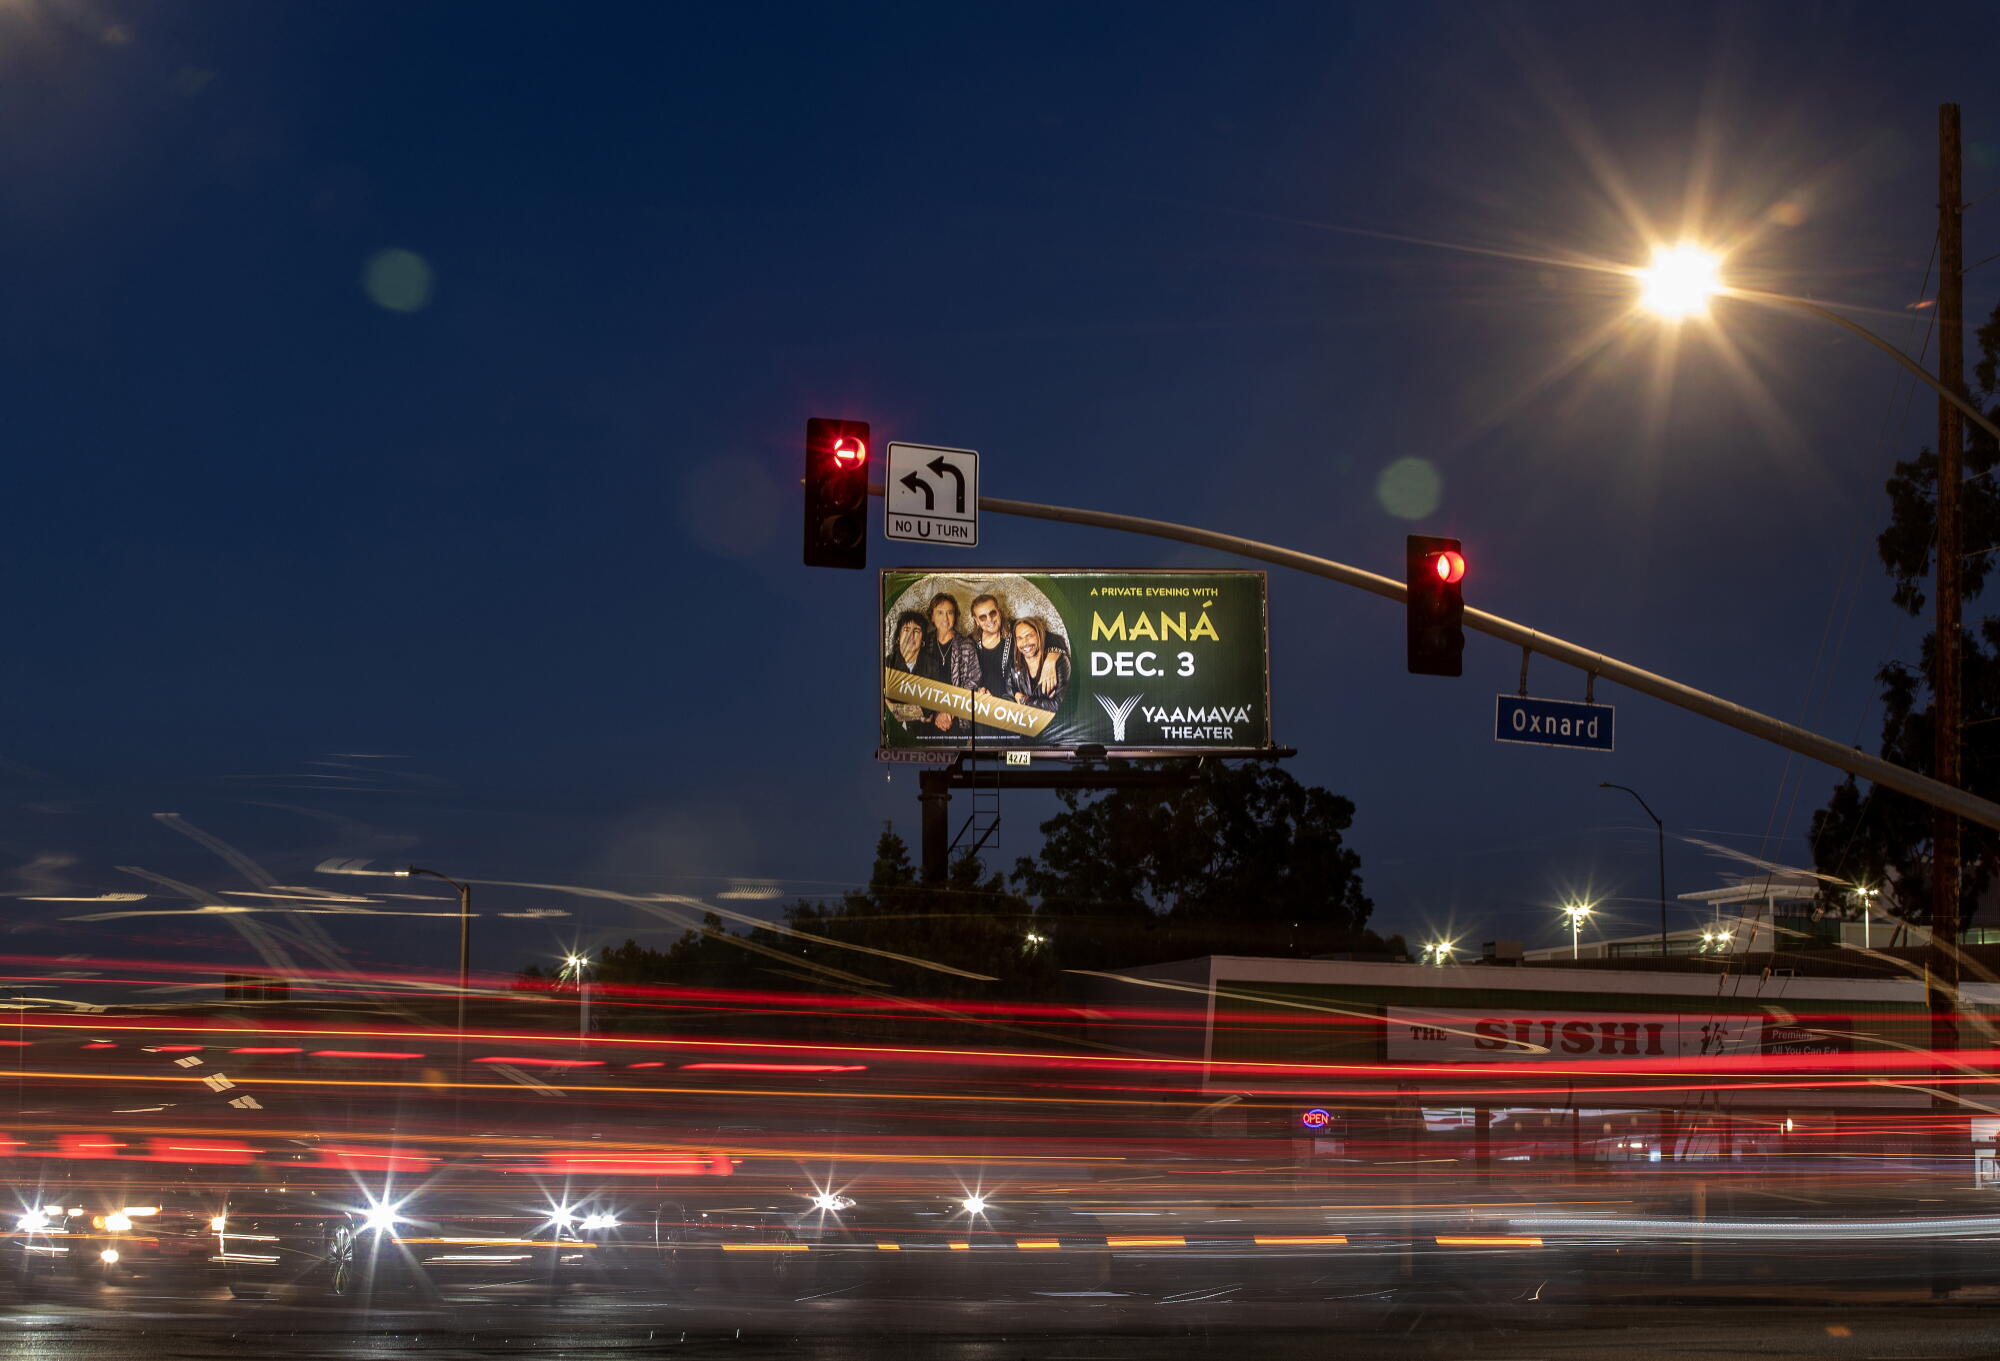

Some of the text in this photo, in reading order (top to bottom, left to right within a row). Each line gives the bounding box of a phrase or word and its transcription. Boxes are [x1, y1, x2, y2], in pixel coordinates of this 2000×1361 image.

[895, 520, 968, 538] NO U TURN
[1090, 587, 1219, 597] A PRIVATE EVENING WITH
[1091, 600, 1220, 642] MANÁ
[1091, 651, 1195, 677] DEC. 3
[899, 680, 1039, 729] INVITATION ONLY
[1512, 708, 1598, 738] Oxnard
[1161, 726, 1233, 740] THEATER
[880, 750, 955, 763] OUTFRONT
[1410, 1018, 1665, 1055] THE SUSHI
[1771, 1029, 1813, 1040] Premium
[1771, 1045, 1839, 1056] All You Can Eat
[1303, 1113, 1328, 1124] OPEN
